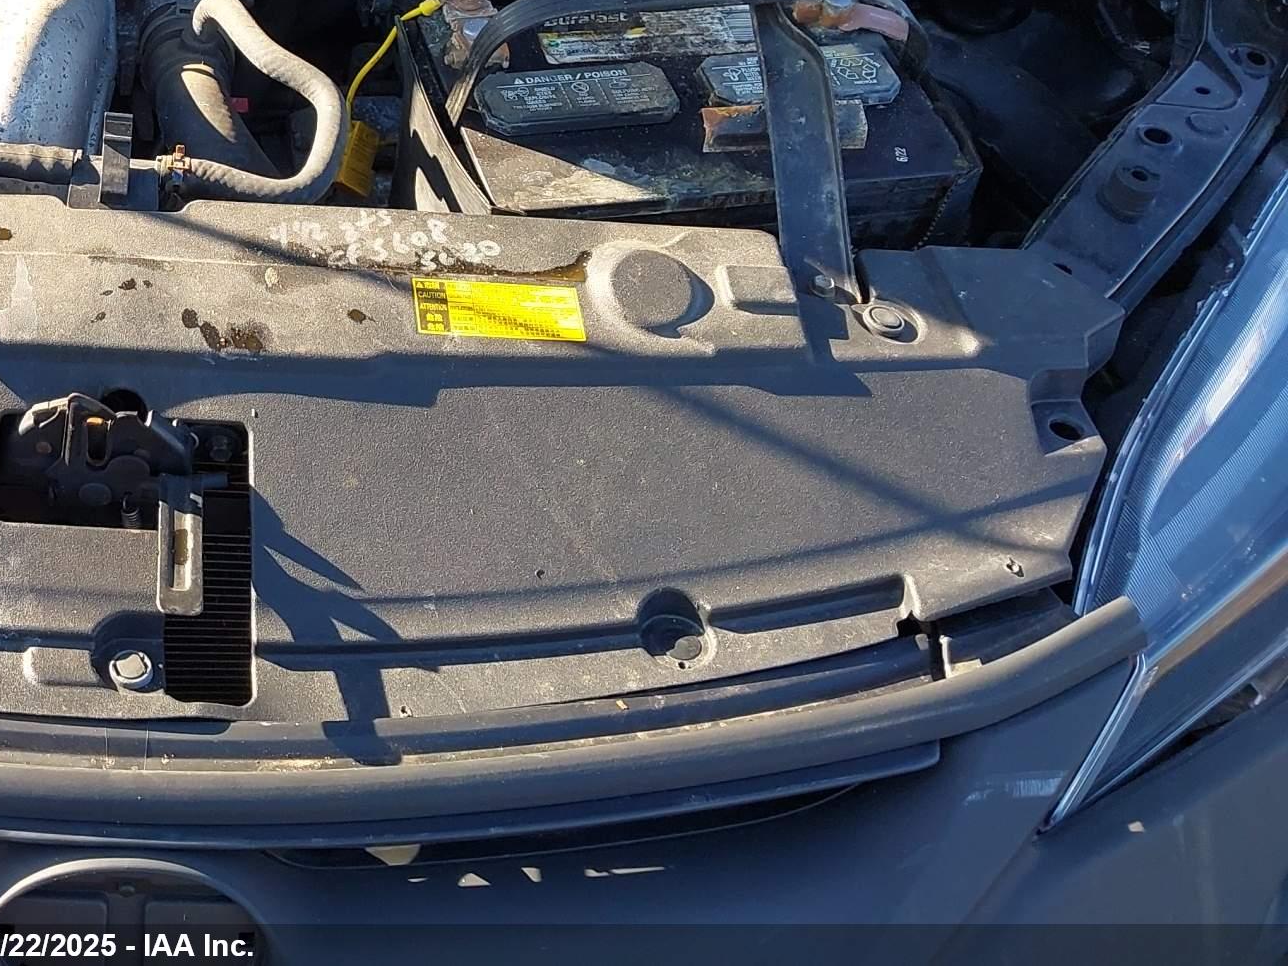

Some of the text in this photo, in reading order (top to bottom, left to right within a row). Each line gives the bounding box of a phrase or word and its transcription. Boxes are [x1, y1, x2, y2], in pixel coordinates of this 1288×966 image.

[525, 73, 573, 84] DANGER
[583, 68, 628, 79] POISON
[417, 290, 446, 299] CAUTION
